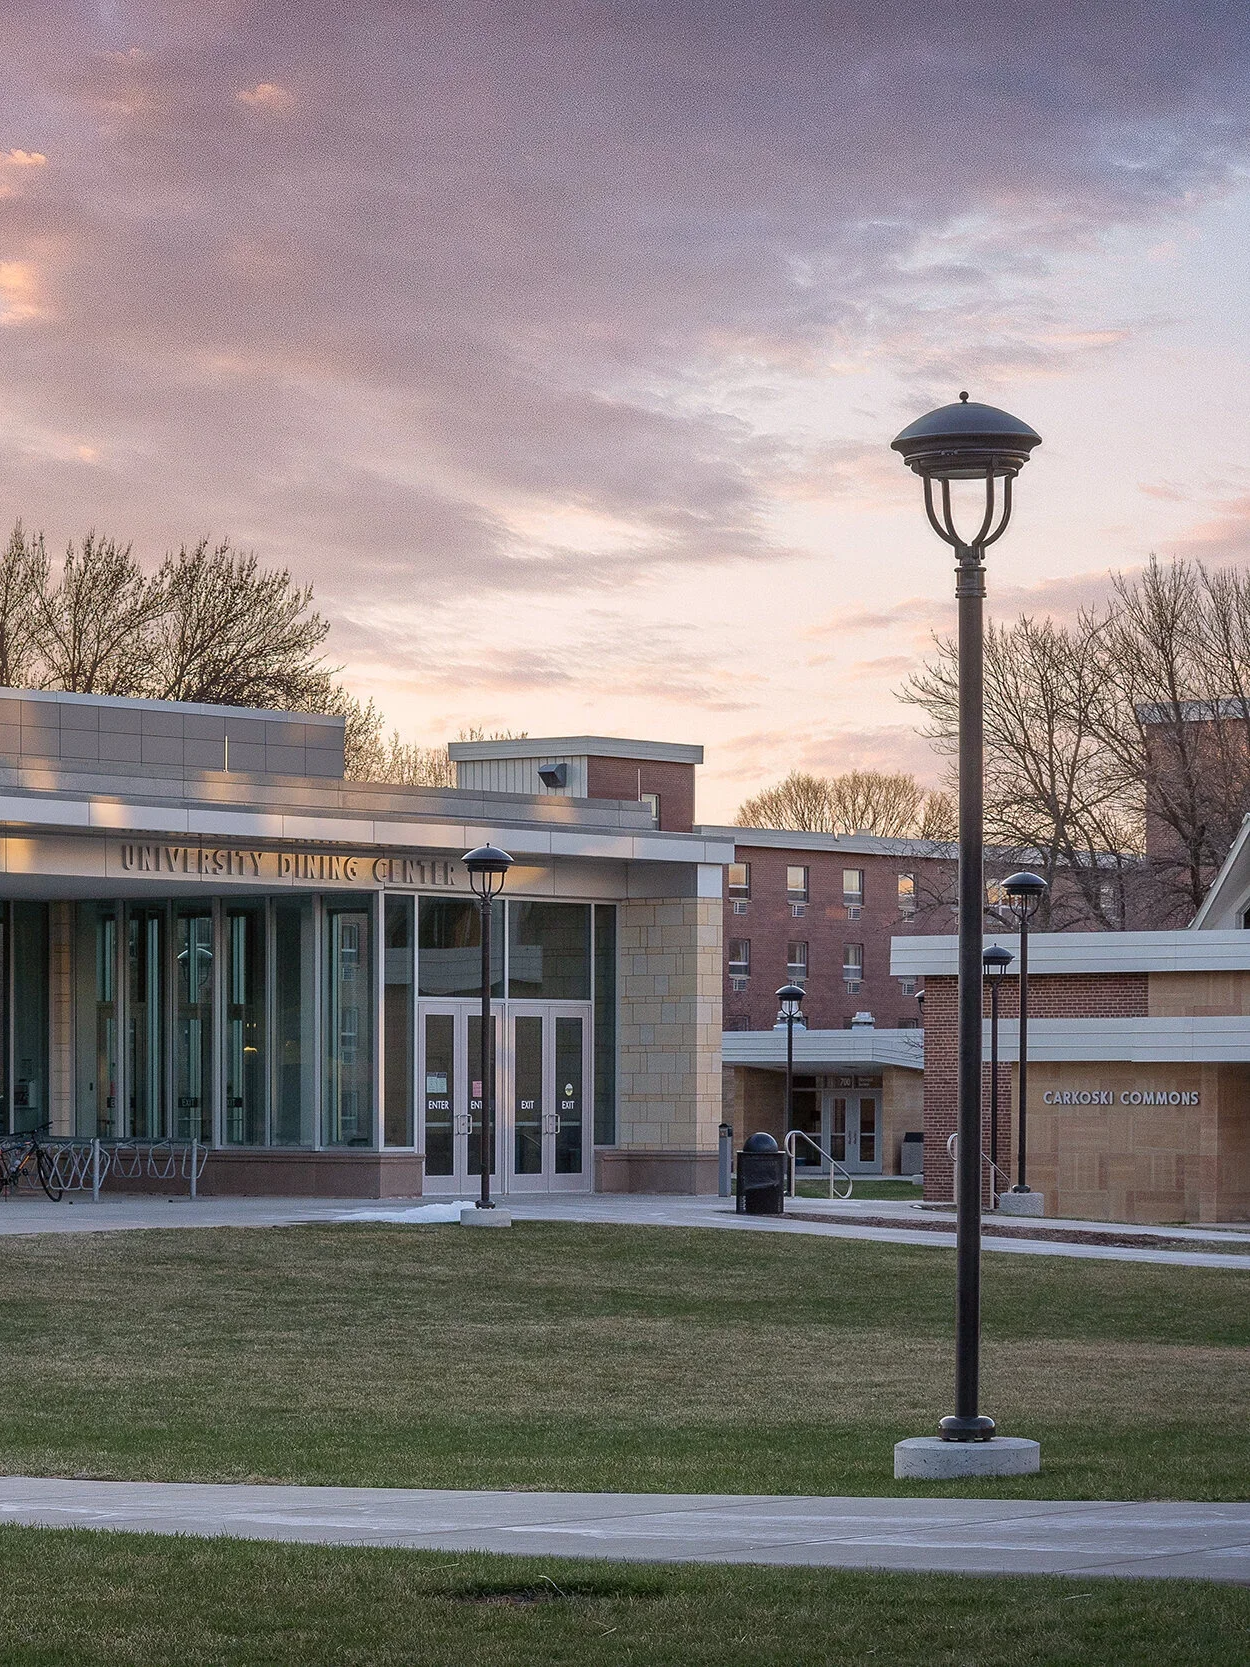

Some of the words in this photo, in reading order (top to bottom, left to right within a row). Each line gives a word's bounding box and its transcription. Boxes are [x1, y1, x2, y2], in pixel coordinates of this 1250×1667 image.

[122, 845, 263, 877] UNIVERSITY
[278, 853, 358, 881] DINING
[372, 857, 455, 885] CENTER
[1043, 1091, 1114, 1105] CARKOSKI
[1120, 1091, 1199, 1105] COMMONS
[428, 1100, 450, 1110] ENTER
[521, 1100, 535, 1110] EXIT
[561, 1100, 575, 1110] EXIT
